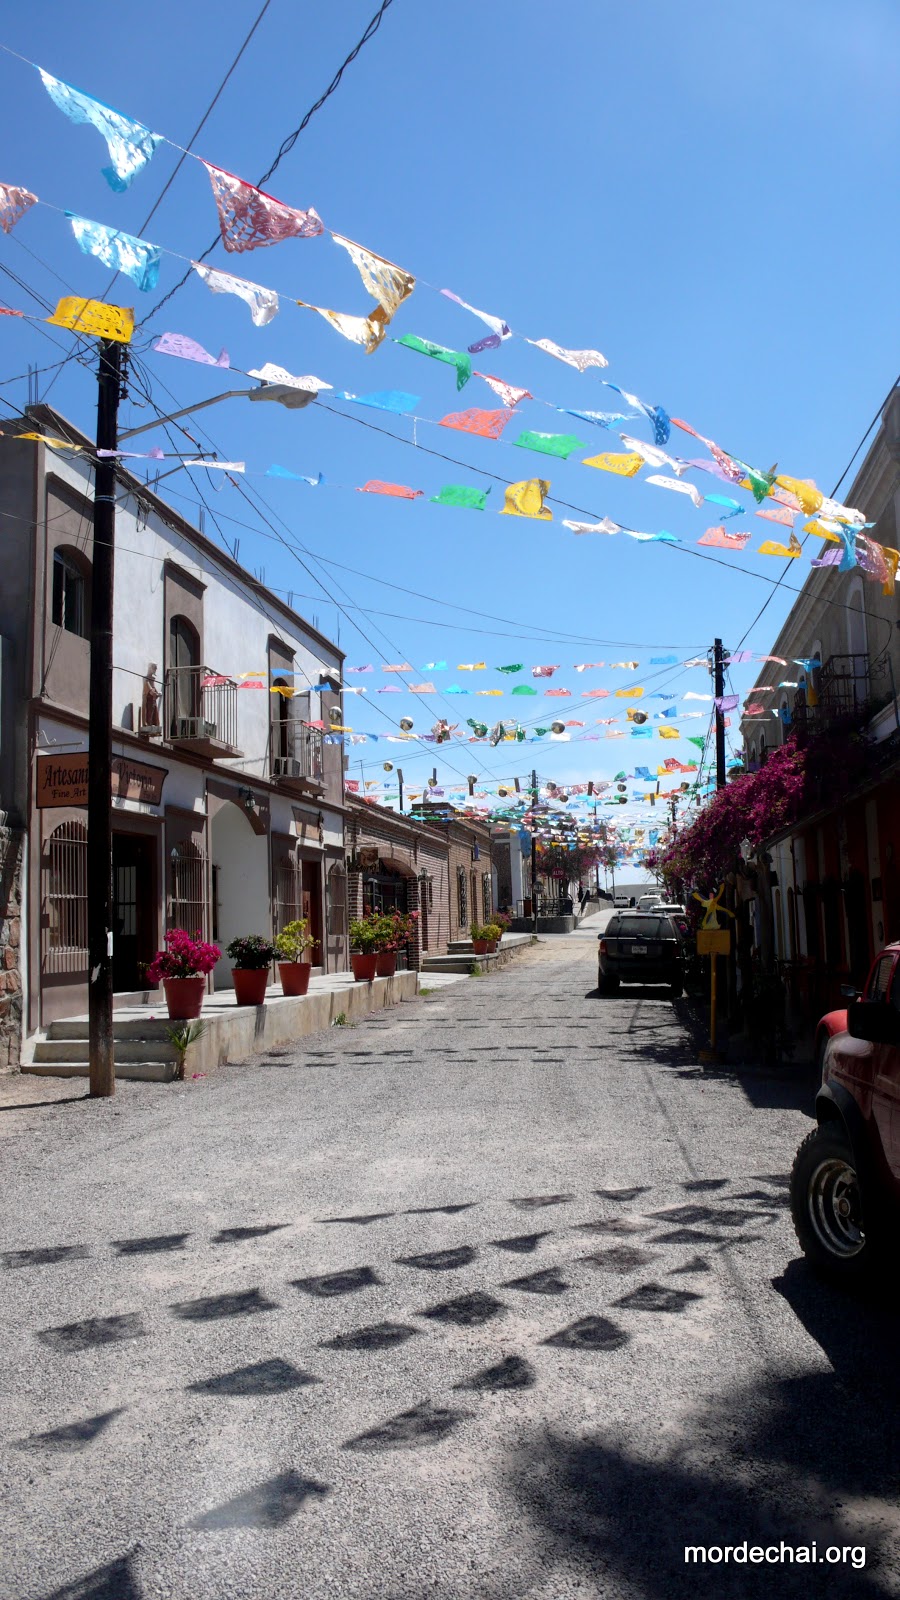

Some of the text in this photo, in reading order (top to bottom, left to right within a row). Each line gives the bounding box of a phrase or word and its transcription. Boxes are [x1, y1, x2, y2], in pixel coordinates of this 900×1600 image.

[43, 765, 89, 789] Artesani
[52, 788, 86, 798] Fine Art
